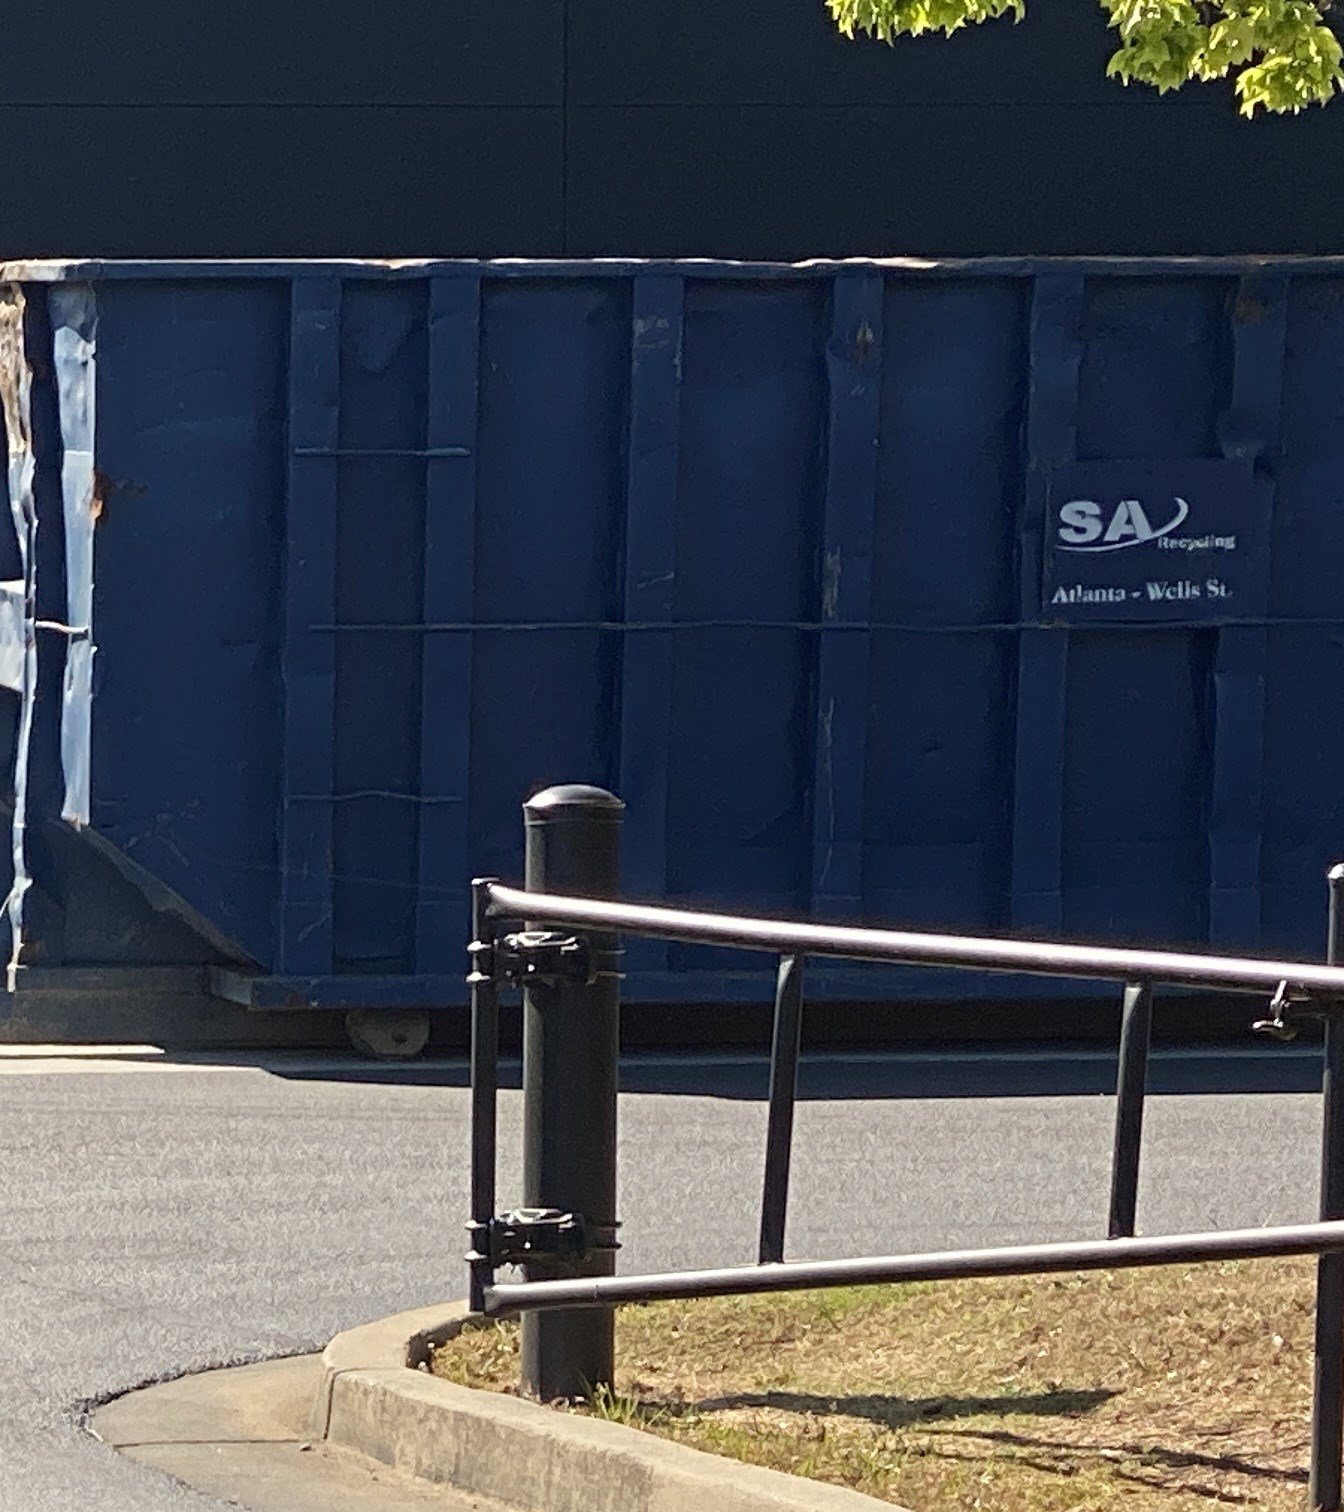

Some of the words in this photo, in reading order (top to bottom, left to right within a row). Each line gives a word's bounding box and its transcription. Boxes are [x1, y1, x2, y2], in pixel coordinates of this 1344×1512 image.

[1058, 499, 1154, 543] SA
[1158, 534, 1236, 551] Recycling
[1051, 585, 1126, 604] Atlanta
[1147, 580, 1201, 601] Wells
[1206, 578, 1234, 599] St.
